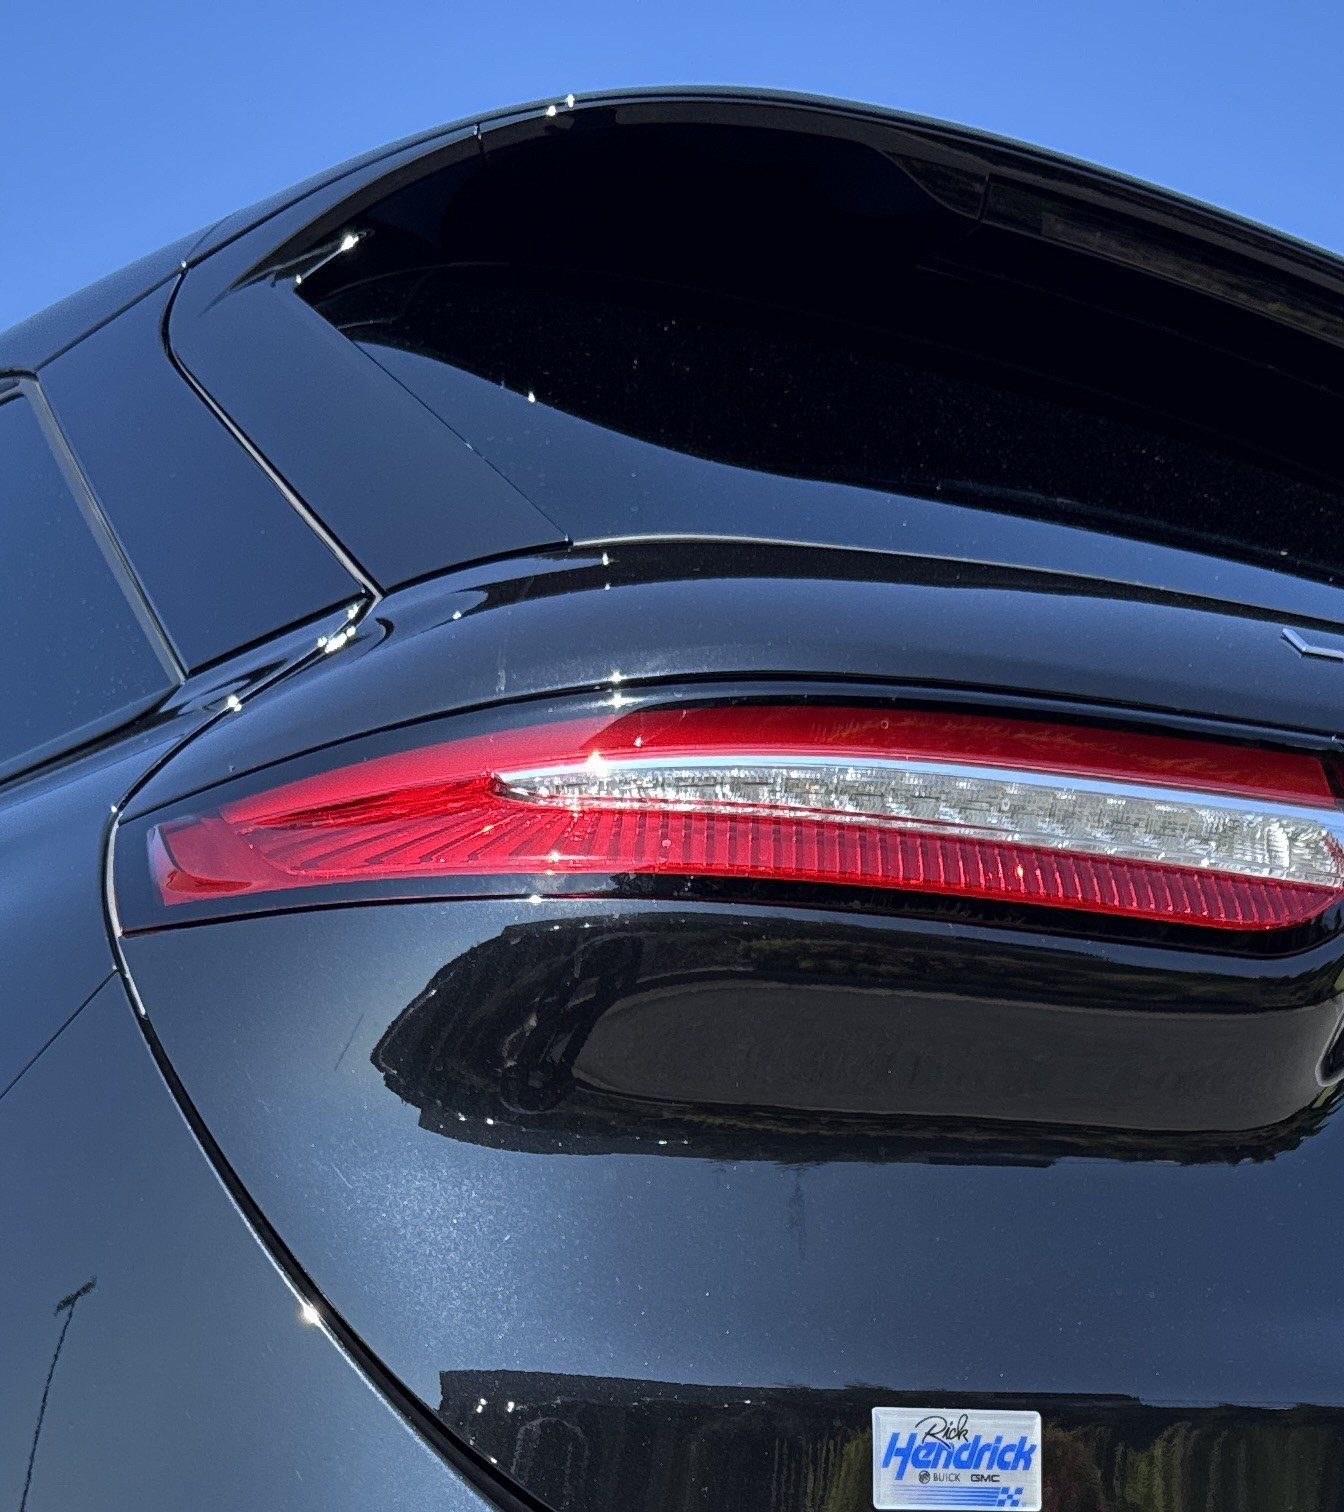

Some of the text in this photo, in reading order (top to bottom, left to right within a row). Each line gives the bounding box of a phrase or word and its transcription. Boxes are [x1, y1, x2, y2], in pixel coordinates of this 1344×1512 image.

[915, 1413, 969, 1450] Rick
[881, 1431, 1037, 1481] Hendrick
[932, 1472, 1001, 1483] BUICK GMC
